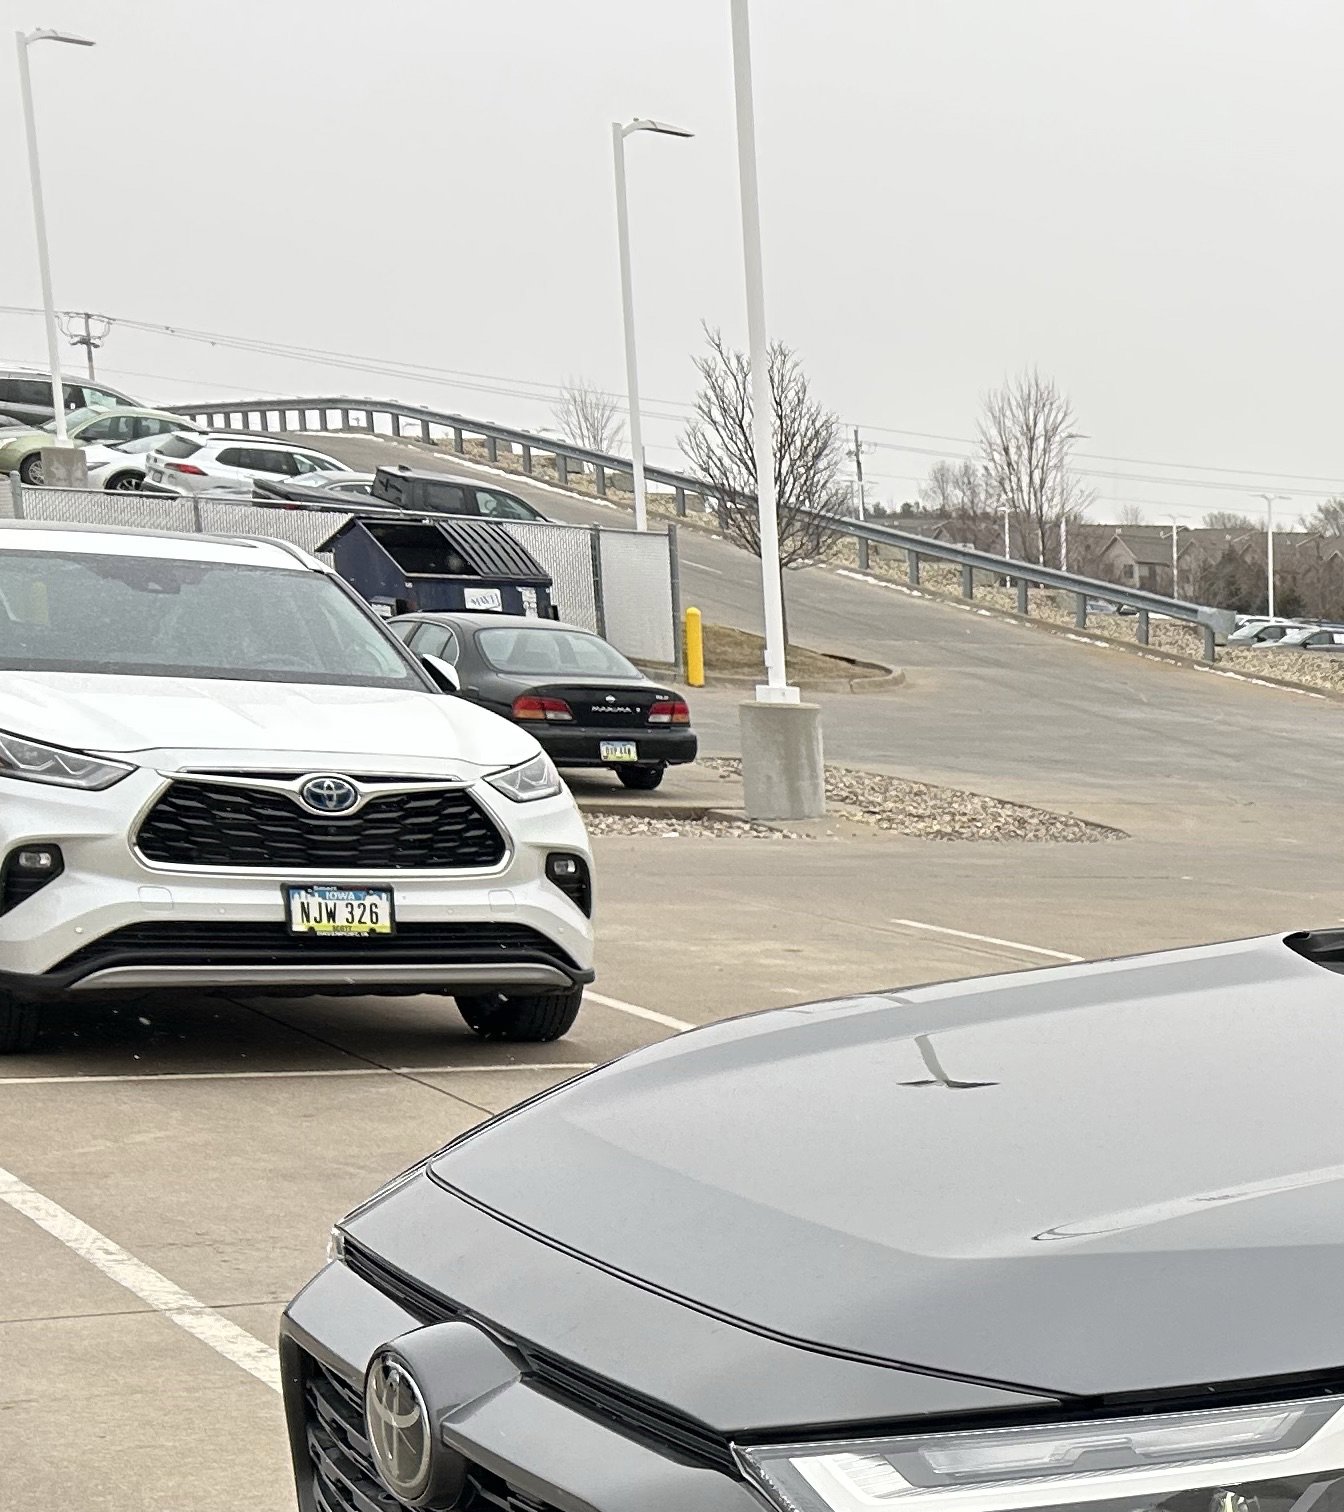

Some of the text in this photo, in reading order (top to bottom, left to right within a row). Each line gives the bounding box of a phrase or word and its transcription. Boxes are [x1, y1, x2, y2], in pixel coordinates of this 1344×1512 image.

[325, 891, 355, 900] IOWA
[300, 901, 379, 925] NJW 326
